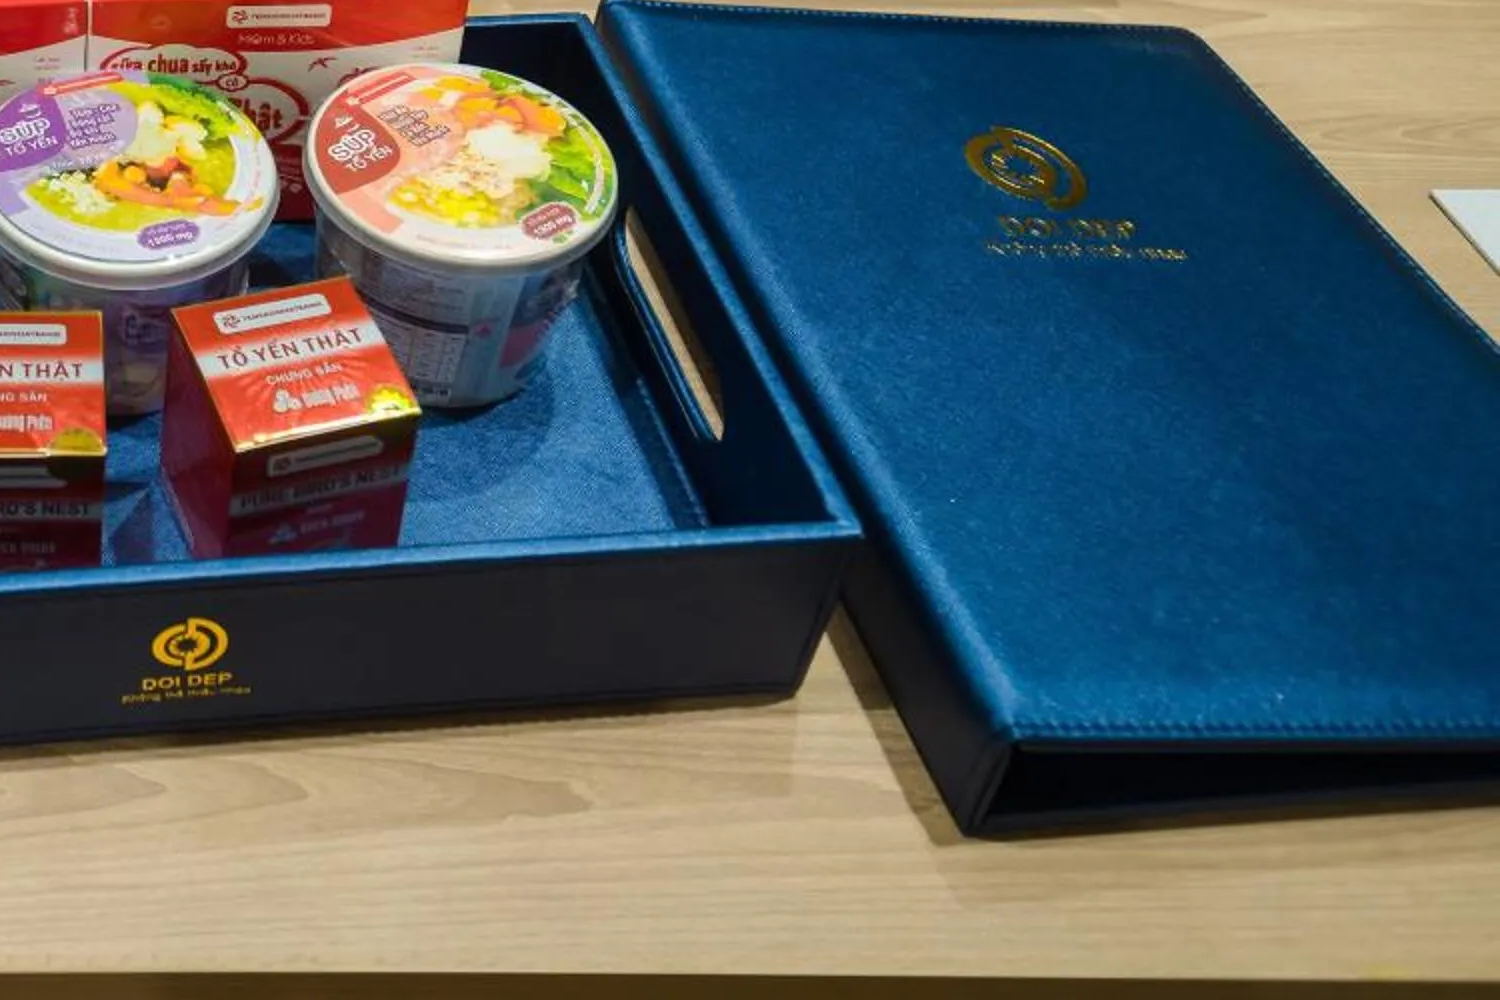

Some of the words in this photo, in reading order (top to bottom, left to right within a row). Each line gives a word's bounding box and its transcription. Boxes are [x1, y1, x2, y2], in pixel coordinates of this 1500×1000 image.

[148, 53, 188, 74] chua
[218, 345, 249, 369] TỔ
[252, 337, 300, 365] YẾN
[306, 328, 364, 354] THẬT
[22, 361, 84, 382] THẬT
[41, 501, 90, 516] NEST
[142, 676, 181, 691] DOI
[187, 671, 233, 687] DEP
